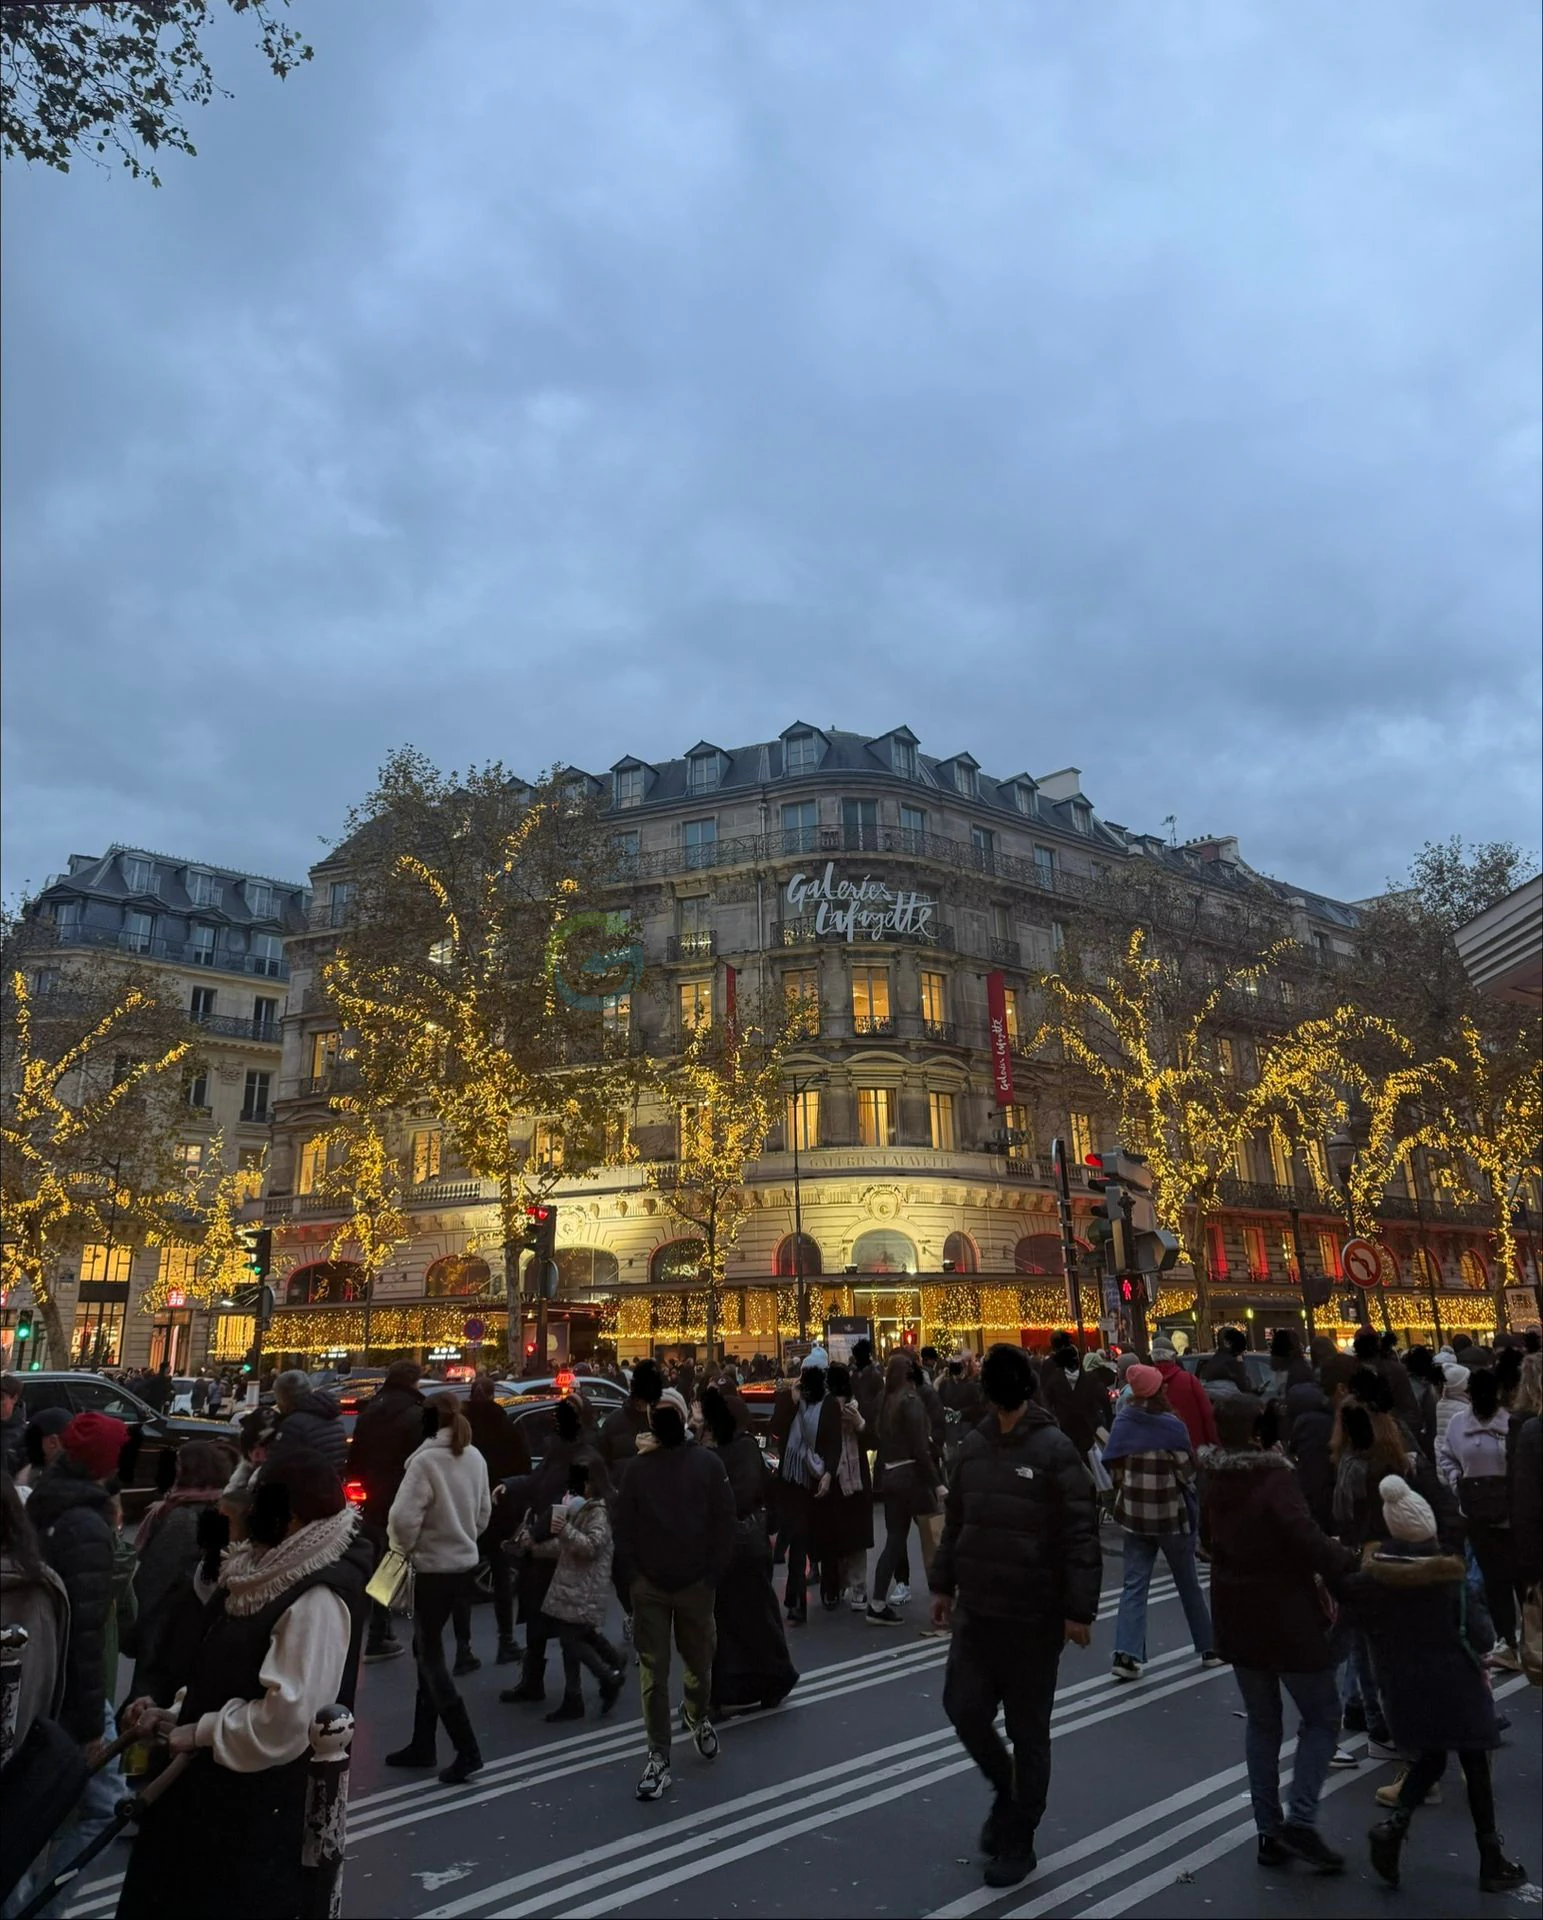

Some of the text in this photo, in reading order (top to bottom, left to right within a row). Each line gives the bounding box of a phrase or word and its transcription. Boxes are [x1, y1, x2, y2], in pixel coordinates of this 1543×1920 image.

[787, 862, 893, 912] Galeries
[816, 892, 939, 942] Lafayette
[810, 1154, 952, 1169] GALERIES LAFAYETTE
